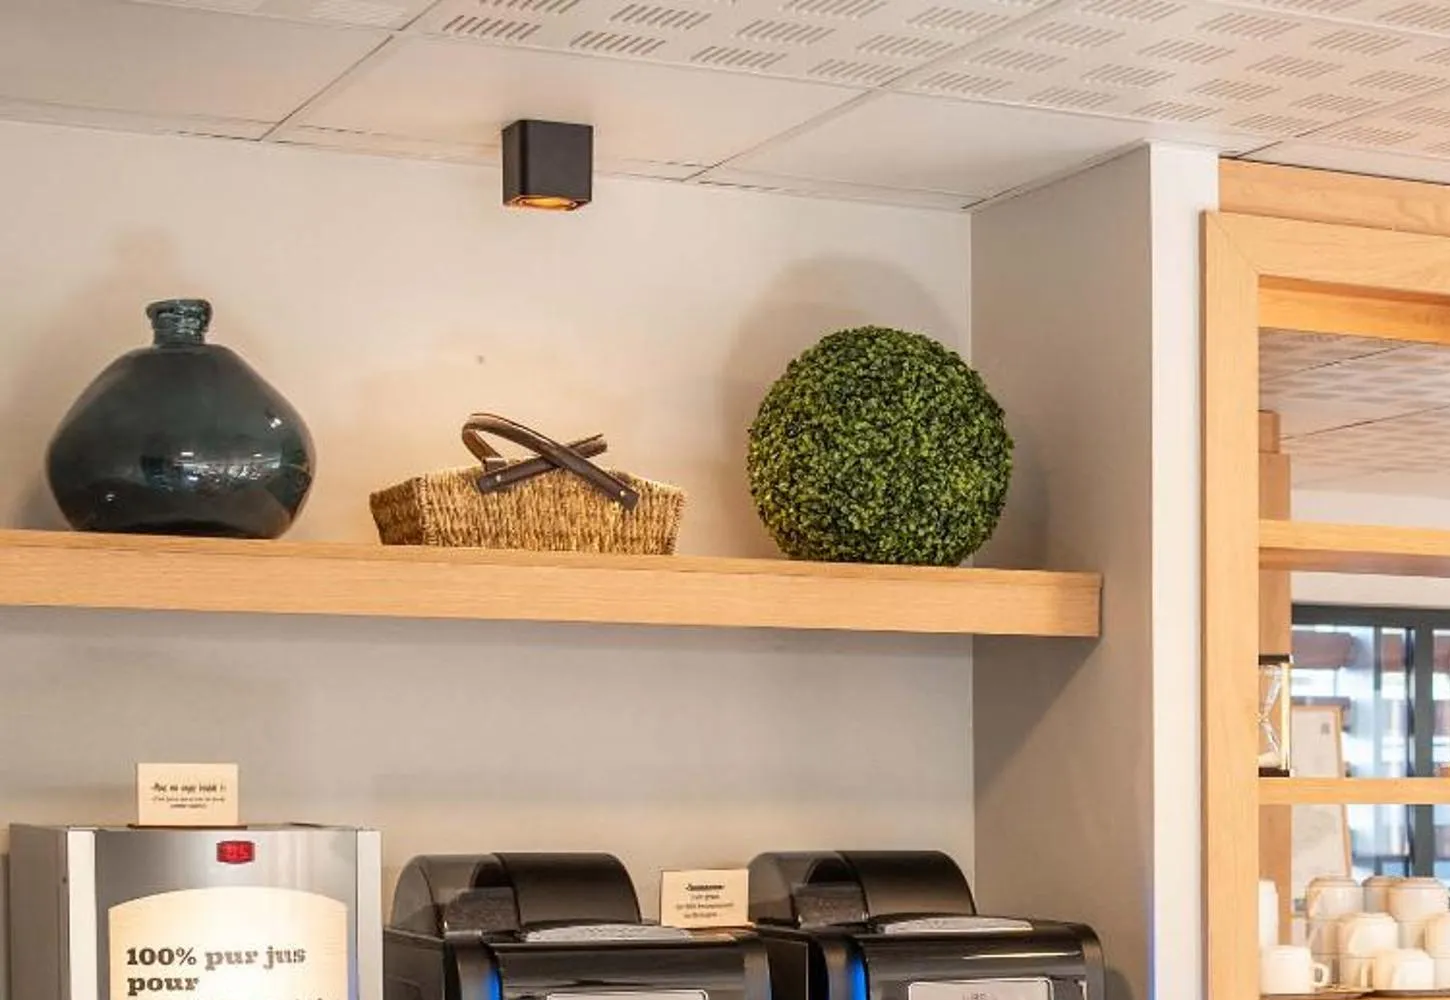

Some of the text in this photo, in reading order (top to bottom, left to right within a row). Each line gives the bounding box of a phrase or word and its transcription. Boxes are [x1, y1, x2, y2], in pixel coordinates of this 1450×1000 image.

[126, 946, 306, 971] 100% pur jus
[127, 976, 199, 997] pour
